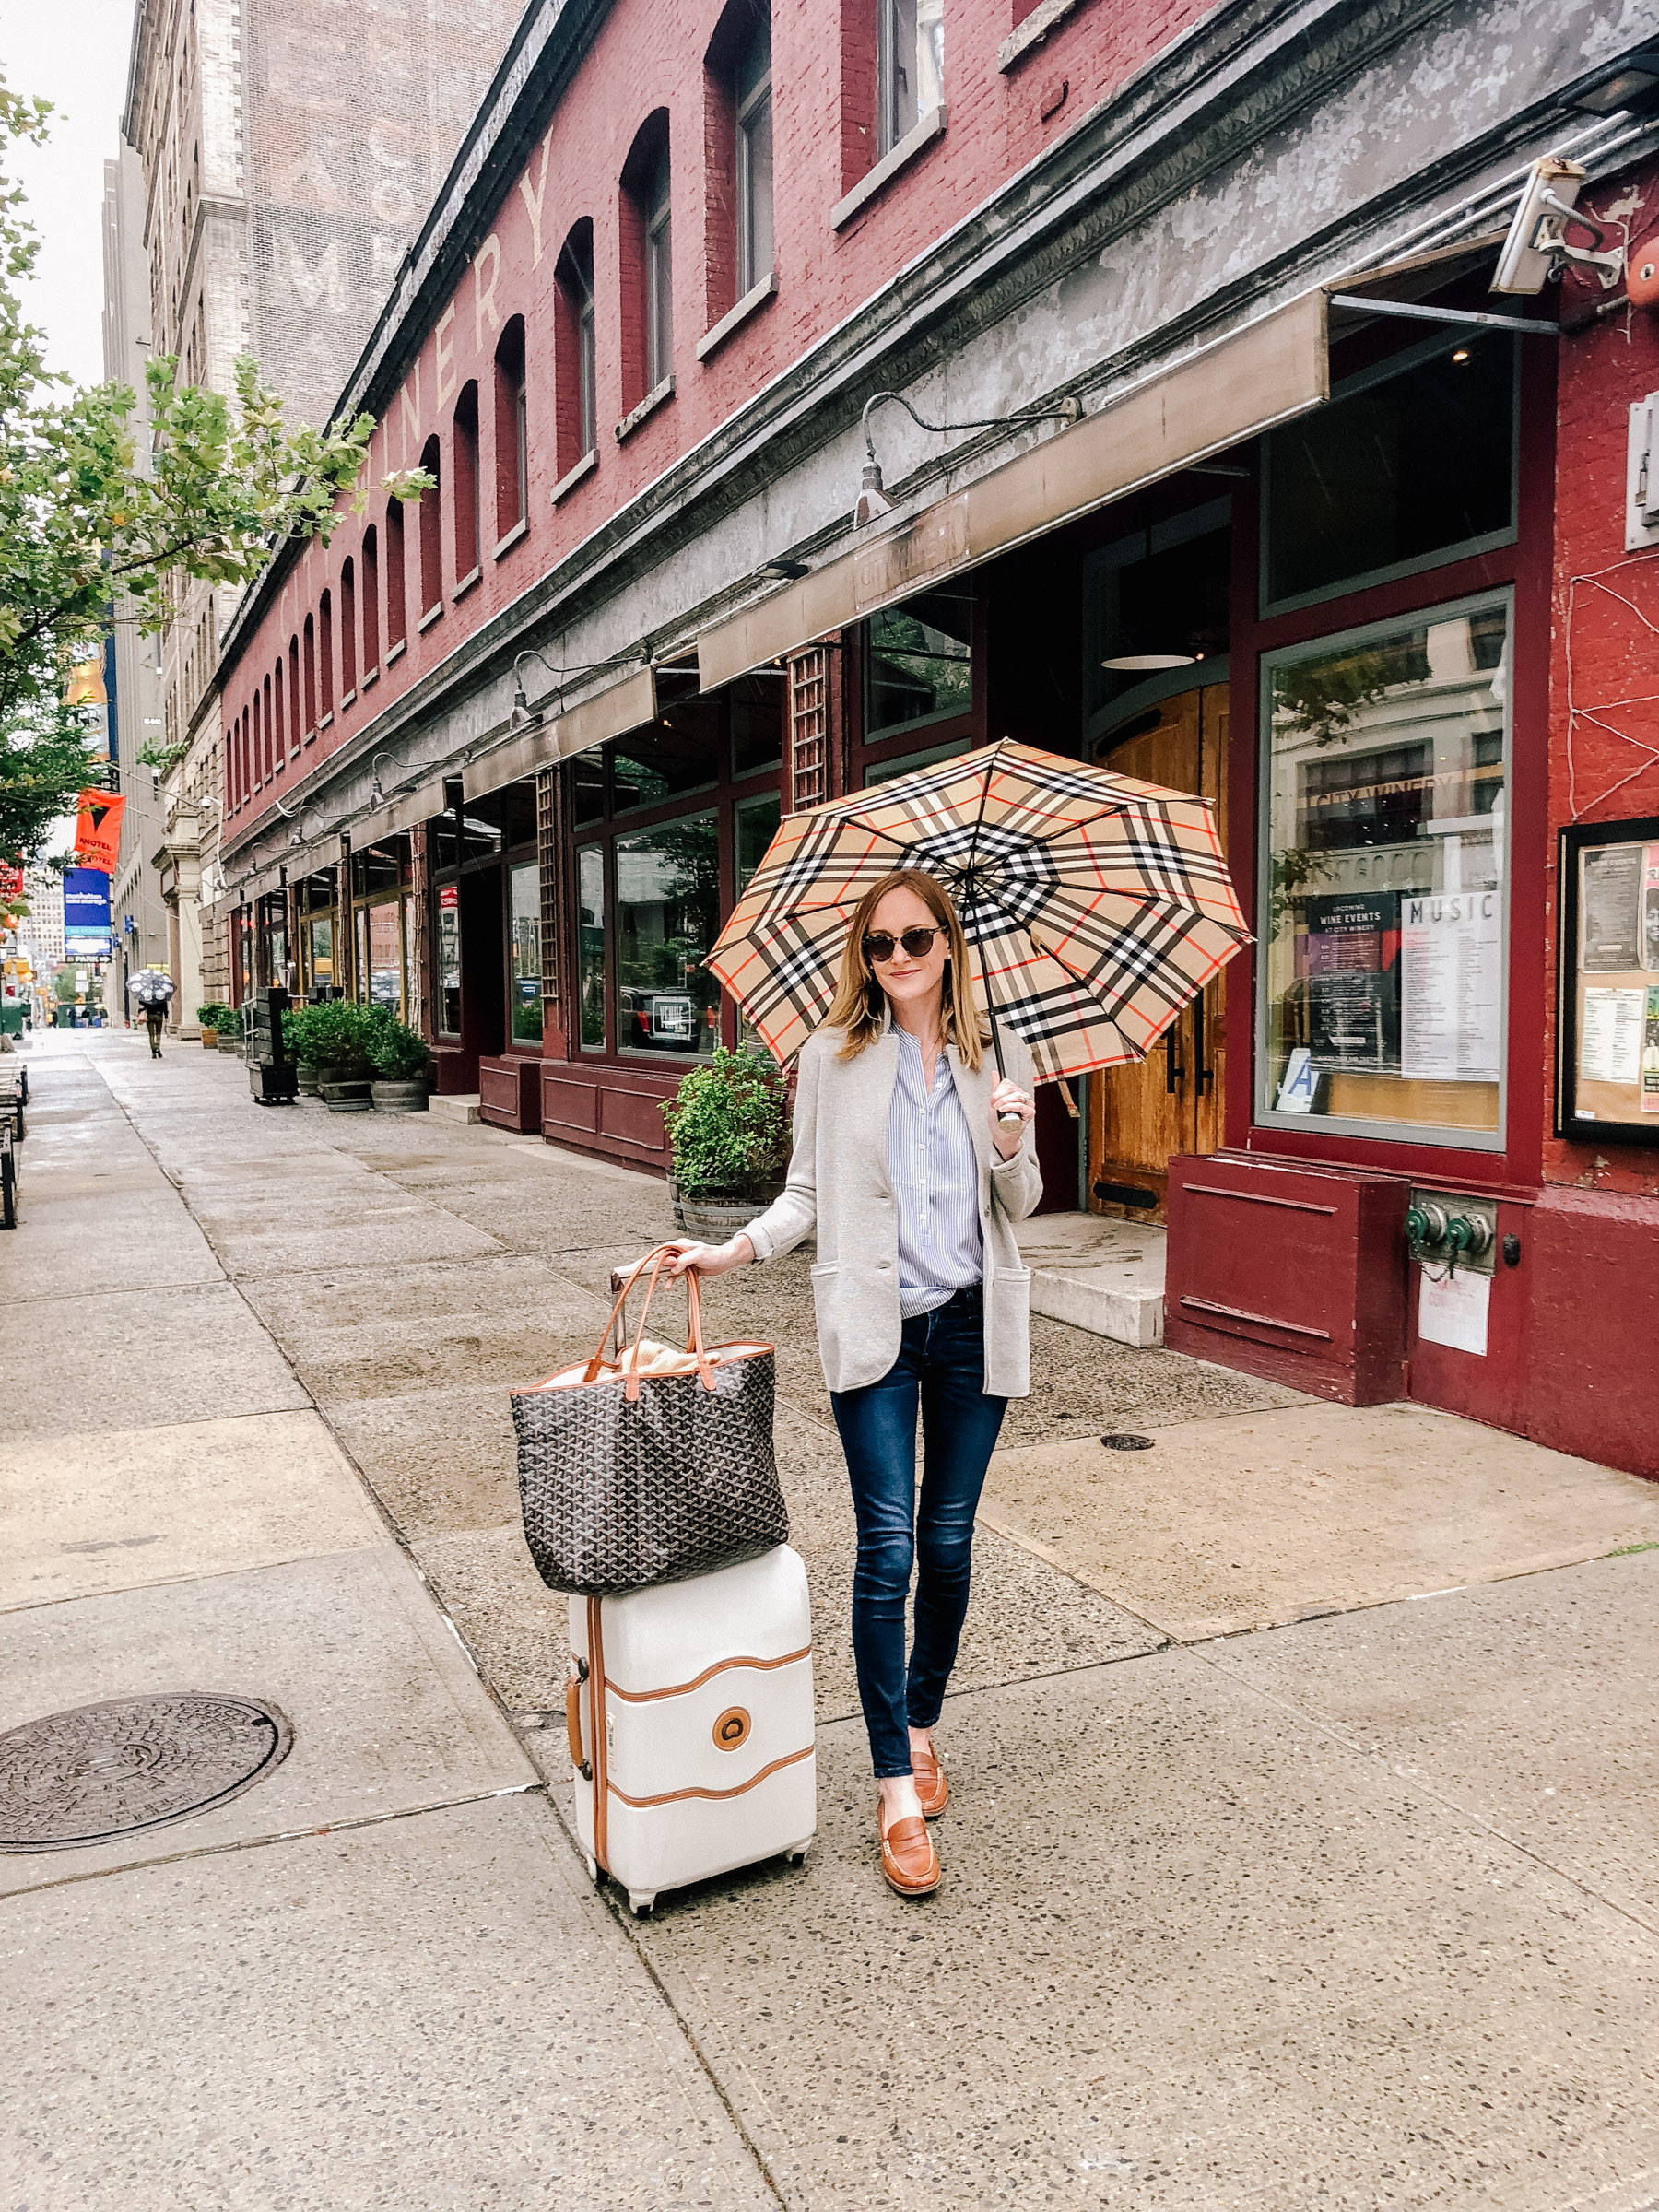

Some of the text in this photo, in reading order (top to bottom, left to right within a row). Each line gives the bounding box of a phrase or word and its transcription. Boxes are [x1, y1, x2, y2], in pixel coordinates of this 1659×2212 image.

[1320, 912, 1381, 925] WINE EVENTS
[1409, 894, 1493, 925] MUSIC
[1287, 1056, 1312, 1096] A
